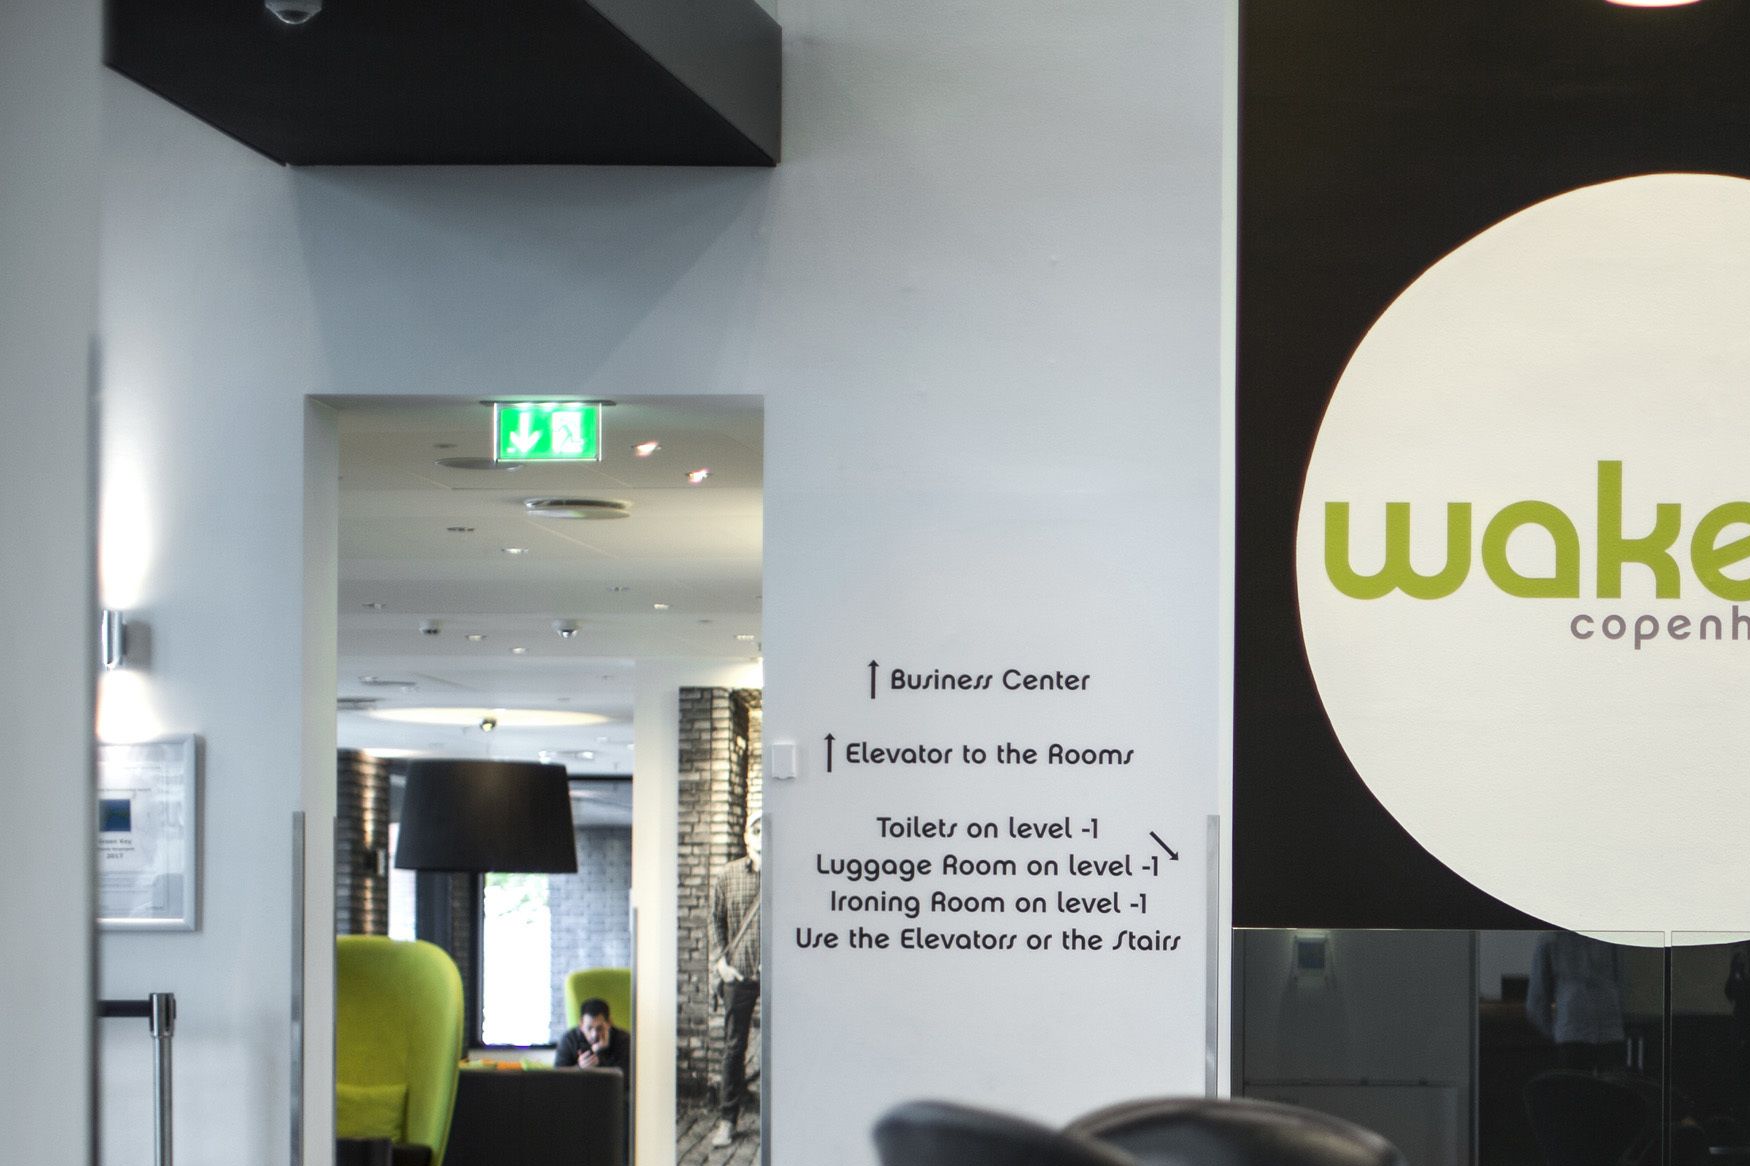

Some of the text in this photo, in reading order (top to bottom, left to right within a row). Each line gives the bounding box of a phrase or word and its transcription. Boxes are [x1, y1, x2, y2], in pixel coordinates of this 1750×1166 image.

[890, 668, 1091, 691] Business Center
[846, 741, 1135, 766] Elevator to the Rooms
[876, 815, 1099, 840] Toilets on level -1
[816, 853, 1160, 882] Luggage Room on level -1
[830, 890, 1148, 919] Ironing Room on level -1
[796, 926, 1182, 952] Use the Elevators or the Stairs
